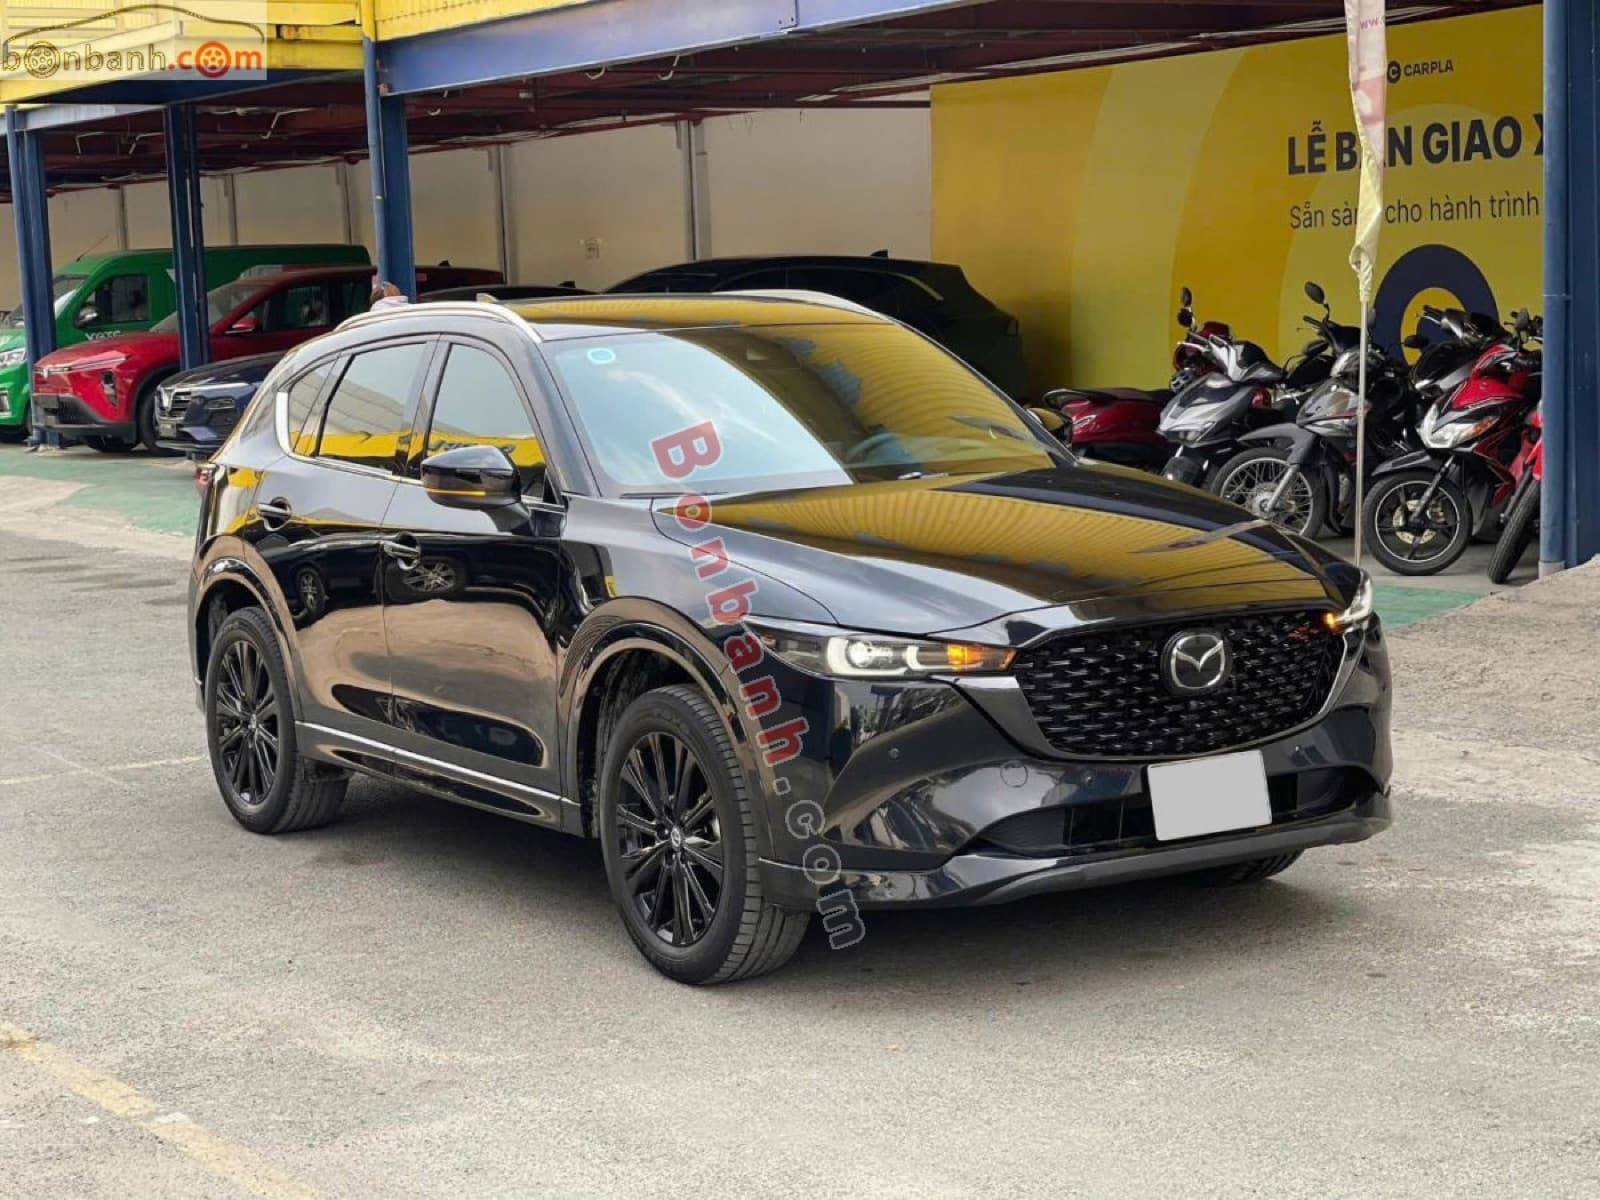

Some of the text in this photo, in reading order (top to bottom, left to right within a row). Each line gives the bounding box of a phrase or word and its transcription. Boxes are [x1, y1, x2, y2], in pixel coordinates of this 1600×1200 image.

[1403, 59, 1454, 77] CARPLA
[1287, 120, 1326, 175] LỄ
[1335, 125, 1413, 172] BN
[1422, 115, 1522, 164] GIAO
[1385, 198, 1422, 224] cho
[1430, 194, 1481, 221] hành
[1489, 191, 1539, 218] trình
